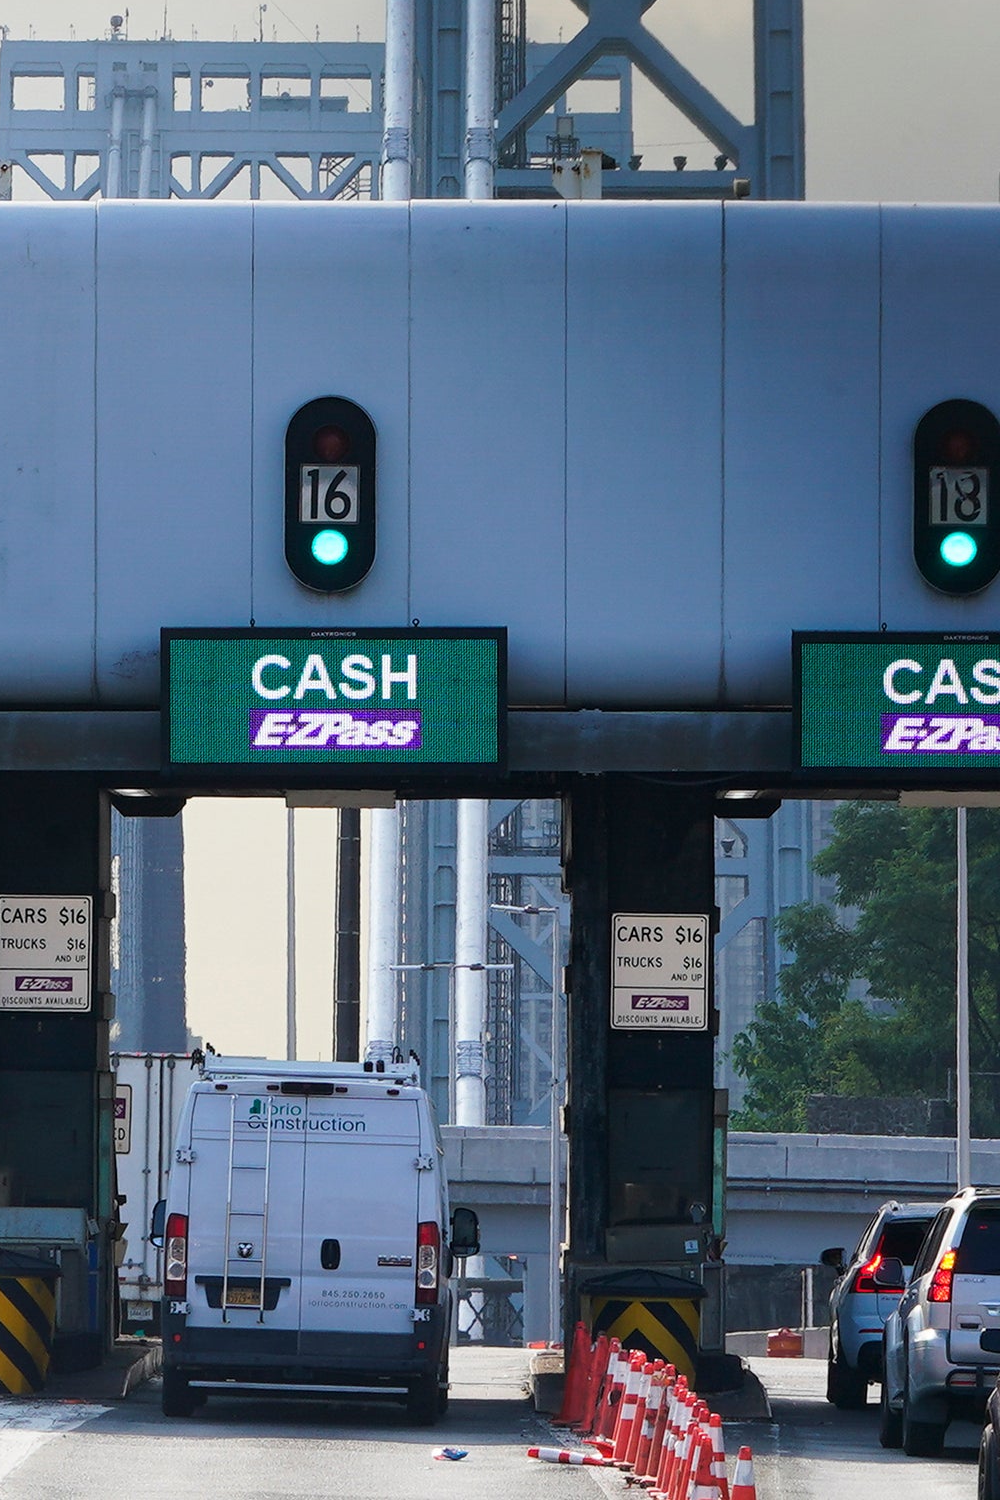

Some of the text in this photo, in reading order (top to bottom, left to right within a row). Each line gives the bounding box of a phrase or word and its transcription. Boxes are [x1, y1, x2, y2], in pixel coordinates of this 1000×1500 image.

[307, 468, 352, 520] 16
[936, 471, 981, 522] 18
[251, 653, 417, 700] CASH
[883, 658, 1000, 705] CAS
[1, 906, 87, 926] CARS $16
[0, 937, 87, 951] TRUCKS $16
[617, 925, 703, 945] CARS $16
[617, 956, 703, 970] TRUCKS $16
[671, 973, 703, 981] AND UP
[1, 996, 42, 1005] DISCOUNTS
[617, 1015, 658, 1024] DISCOUNTS
[248, 1115, 366, 1133] Construction
